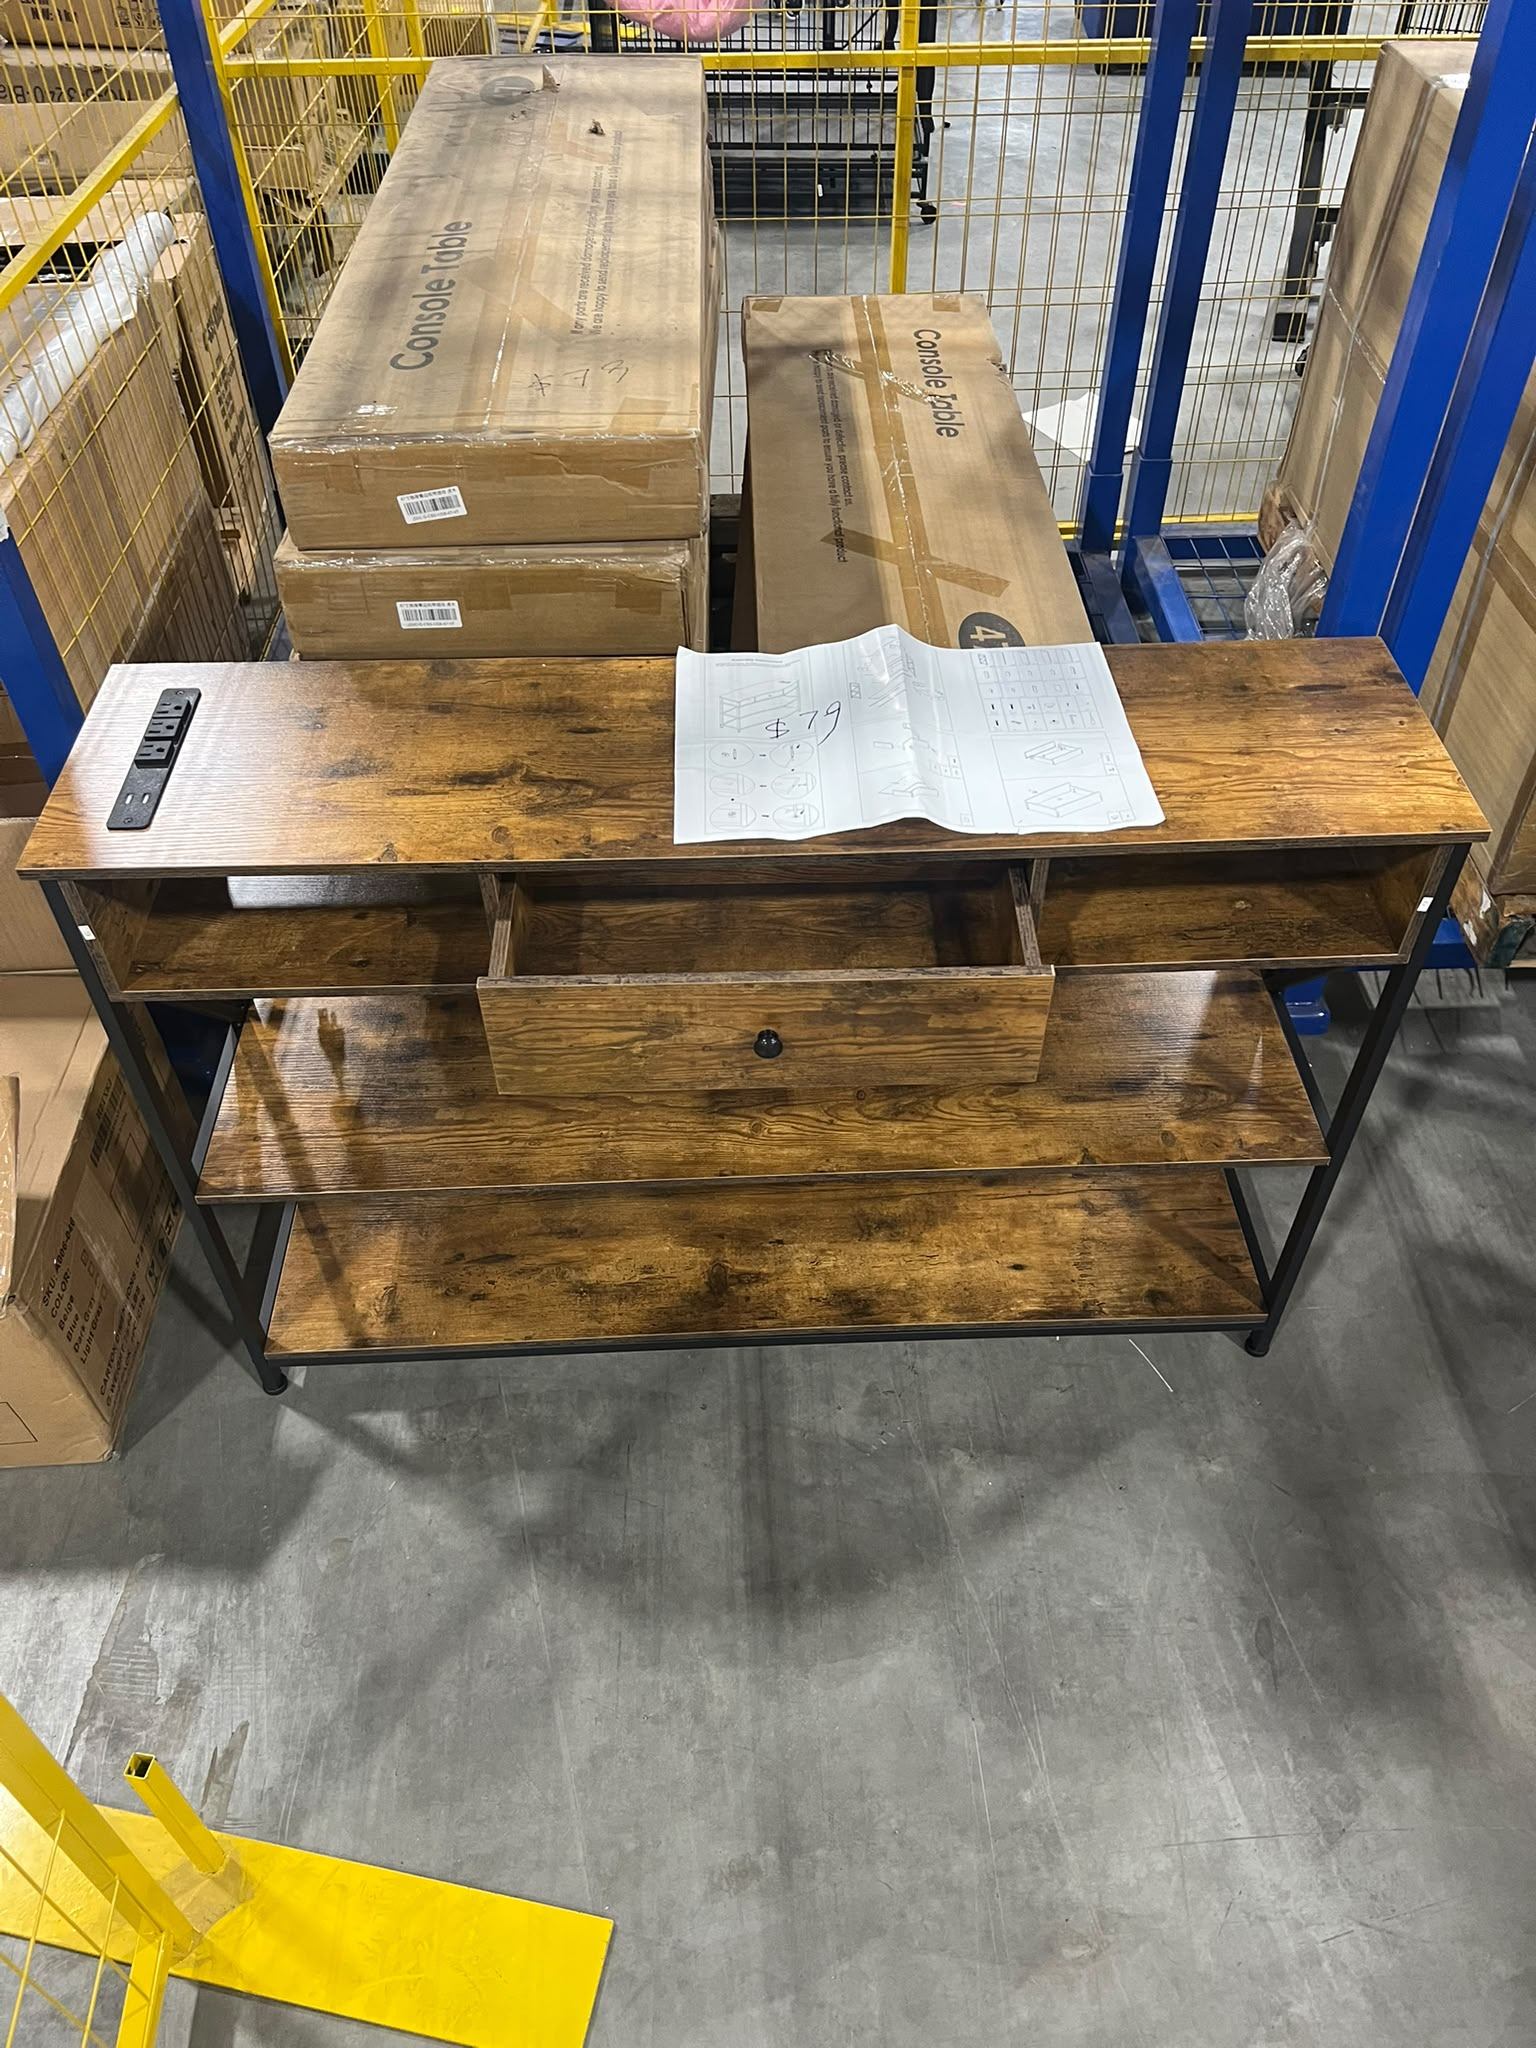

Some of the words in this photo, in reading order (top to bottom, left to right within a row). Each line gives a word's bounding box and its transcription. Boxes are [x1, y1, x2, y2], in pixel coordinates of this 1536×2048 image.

[421, 221, 473, 274] Table
[580, 263, 591, 288] received
[597, 270, 608, 284] send
[578, 289, 588, 300] are
[595, 284, 607, 292] to
[575, 301, 588, 317] parts
[591, 293, 608, 312] happy
[389, 279, 456, 371] Console
[574, 317, 588, 329] any
[593, 313, 603, 323] are
[913, 329, 952, 389] Console
[928, 393, 965, 438] Table
[820, 425, 829, 437] parts
[824, 445, 832, 461] ensure
[824, 463, 834, 473] you
[828, 474, 836, 488] have
[841, 475, 853, 497] contact
[829, 495, 841, 506] fully
[831, 507, 845, 537] functional
[833, 538, 848, 562] product
[42, 1274, 58, 1306] SKU:
[51, 1267, 71, 1318] COLOR:
[58, 1295, 74, 1331] Beige
[74, 1325, 86, 1353] Dark
[84, 1297, 95, 1322] Gray
[66, 1313, 79, 1342] Blue
[81, 1331, 94, 1364] Light
[91, 1305, 103, 1330] Gray
[100, 1347, 117, 1396] CARTON
